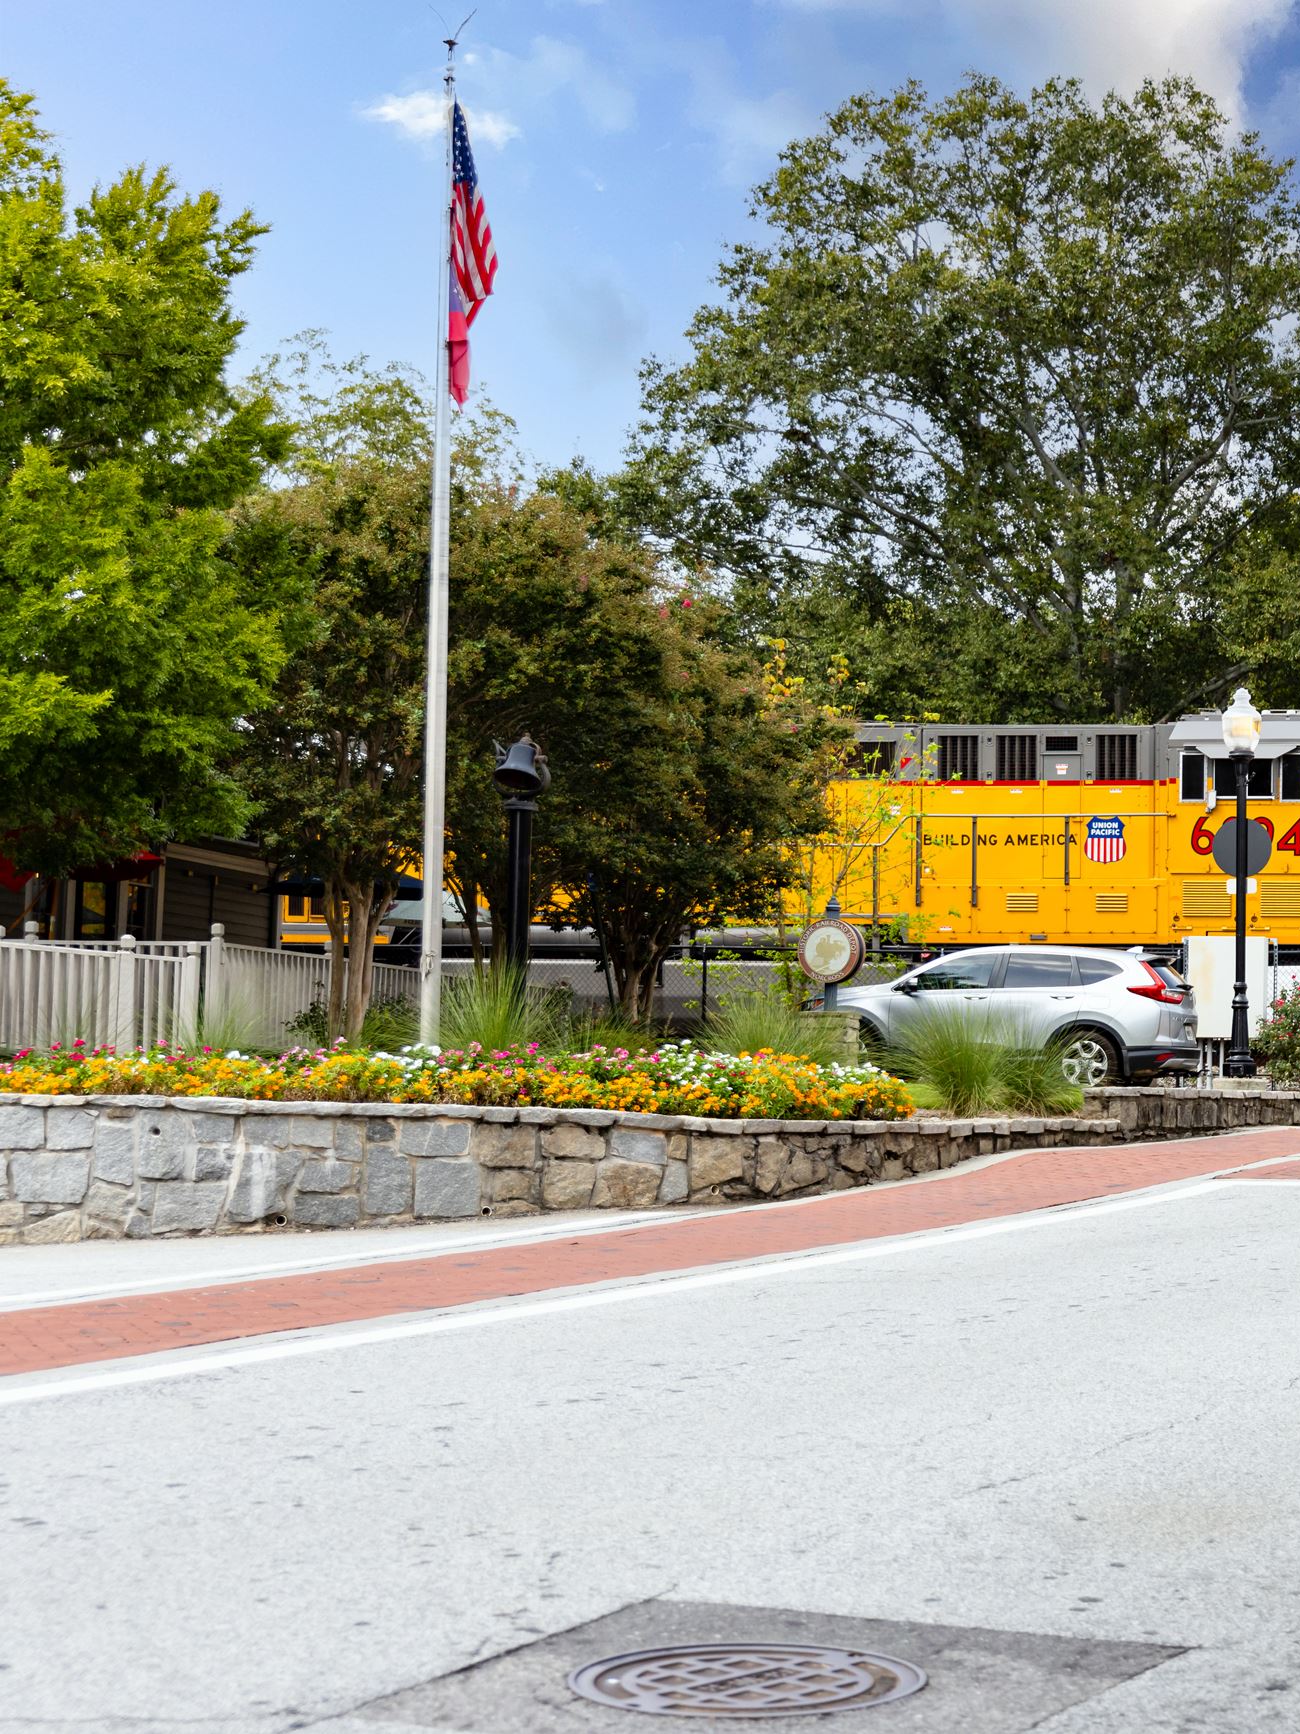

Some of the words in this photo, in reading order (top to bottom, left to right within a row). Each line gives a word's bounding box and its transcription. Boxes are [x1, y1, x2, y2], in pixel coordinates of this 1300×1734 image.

[923, 834, 998, 846] BUILDNG
[1004, 834, 1077, 846] AMERICA
[799, 925, 816, 954] HISTORIC
[816, 920, 848, 934] RAILROAD
[846, 932, 857, 954] DEPOT
